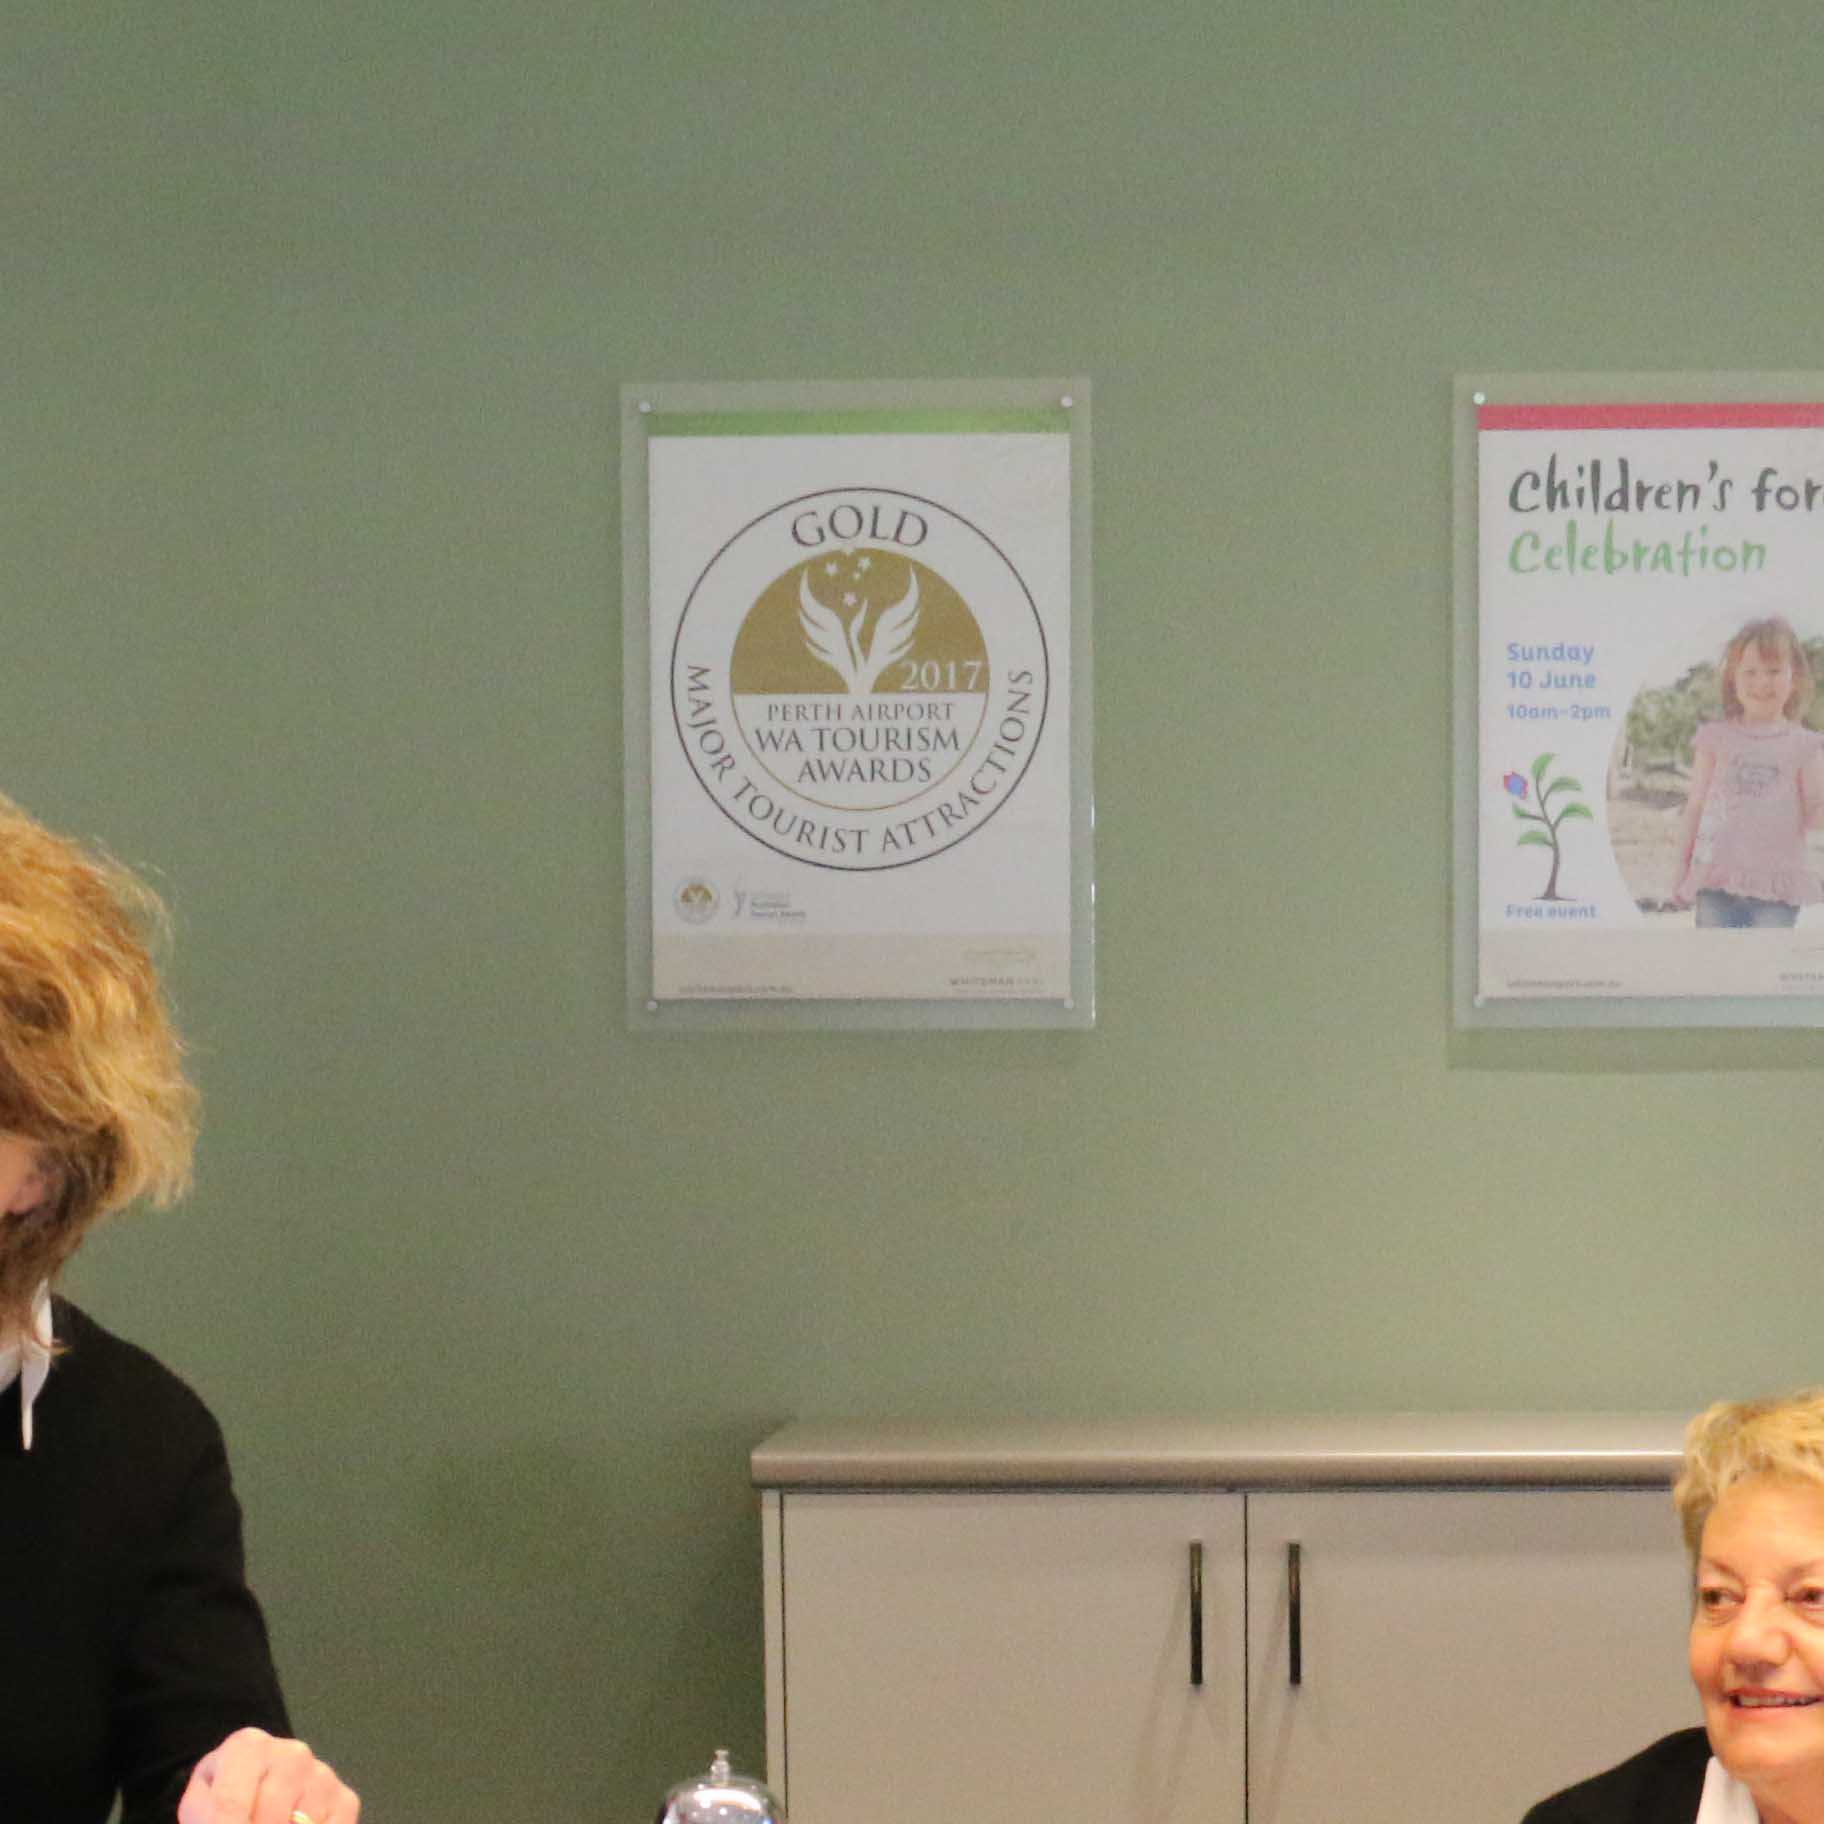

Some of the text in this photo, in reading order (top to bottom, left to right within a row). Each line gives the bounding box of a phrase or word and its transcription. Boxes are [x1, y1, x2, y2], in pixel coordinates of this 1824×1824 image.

[1508, 452, 1733, 514] Children's
[792, 504, 928, 548] GOLD
[1508, 519, 1767, 576] Celebration
[1506, 642, 1594, 666] Sunday
[901, 660, 982, 692] 2017
[1506, 671, 1596, 690] 10 June
[767, 702, 954, 722] PERTH AIRPORT
[756, 727, 960, 752] WA TOURISM
[686, 664, 1033, 854] MAJOR TOURIST ATTRACTIONS
[797, 758, 932, 784] AWARDS
